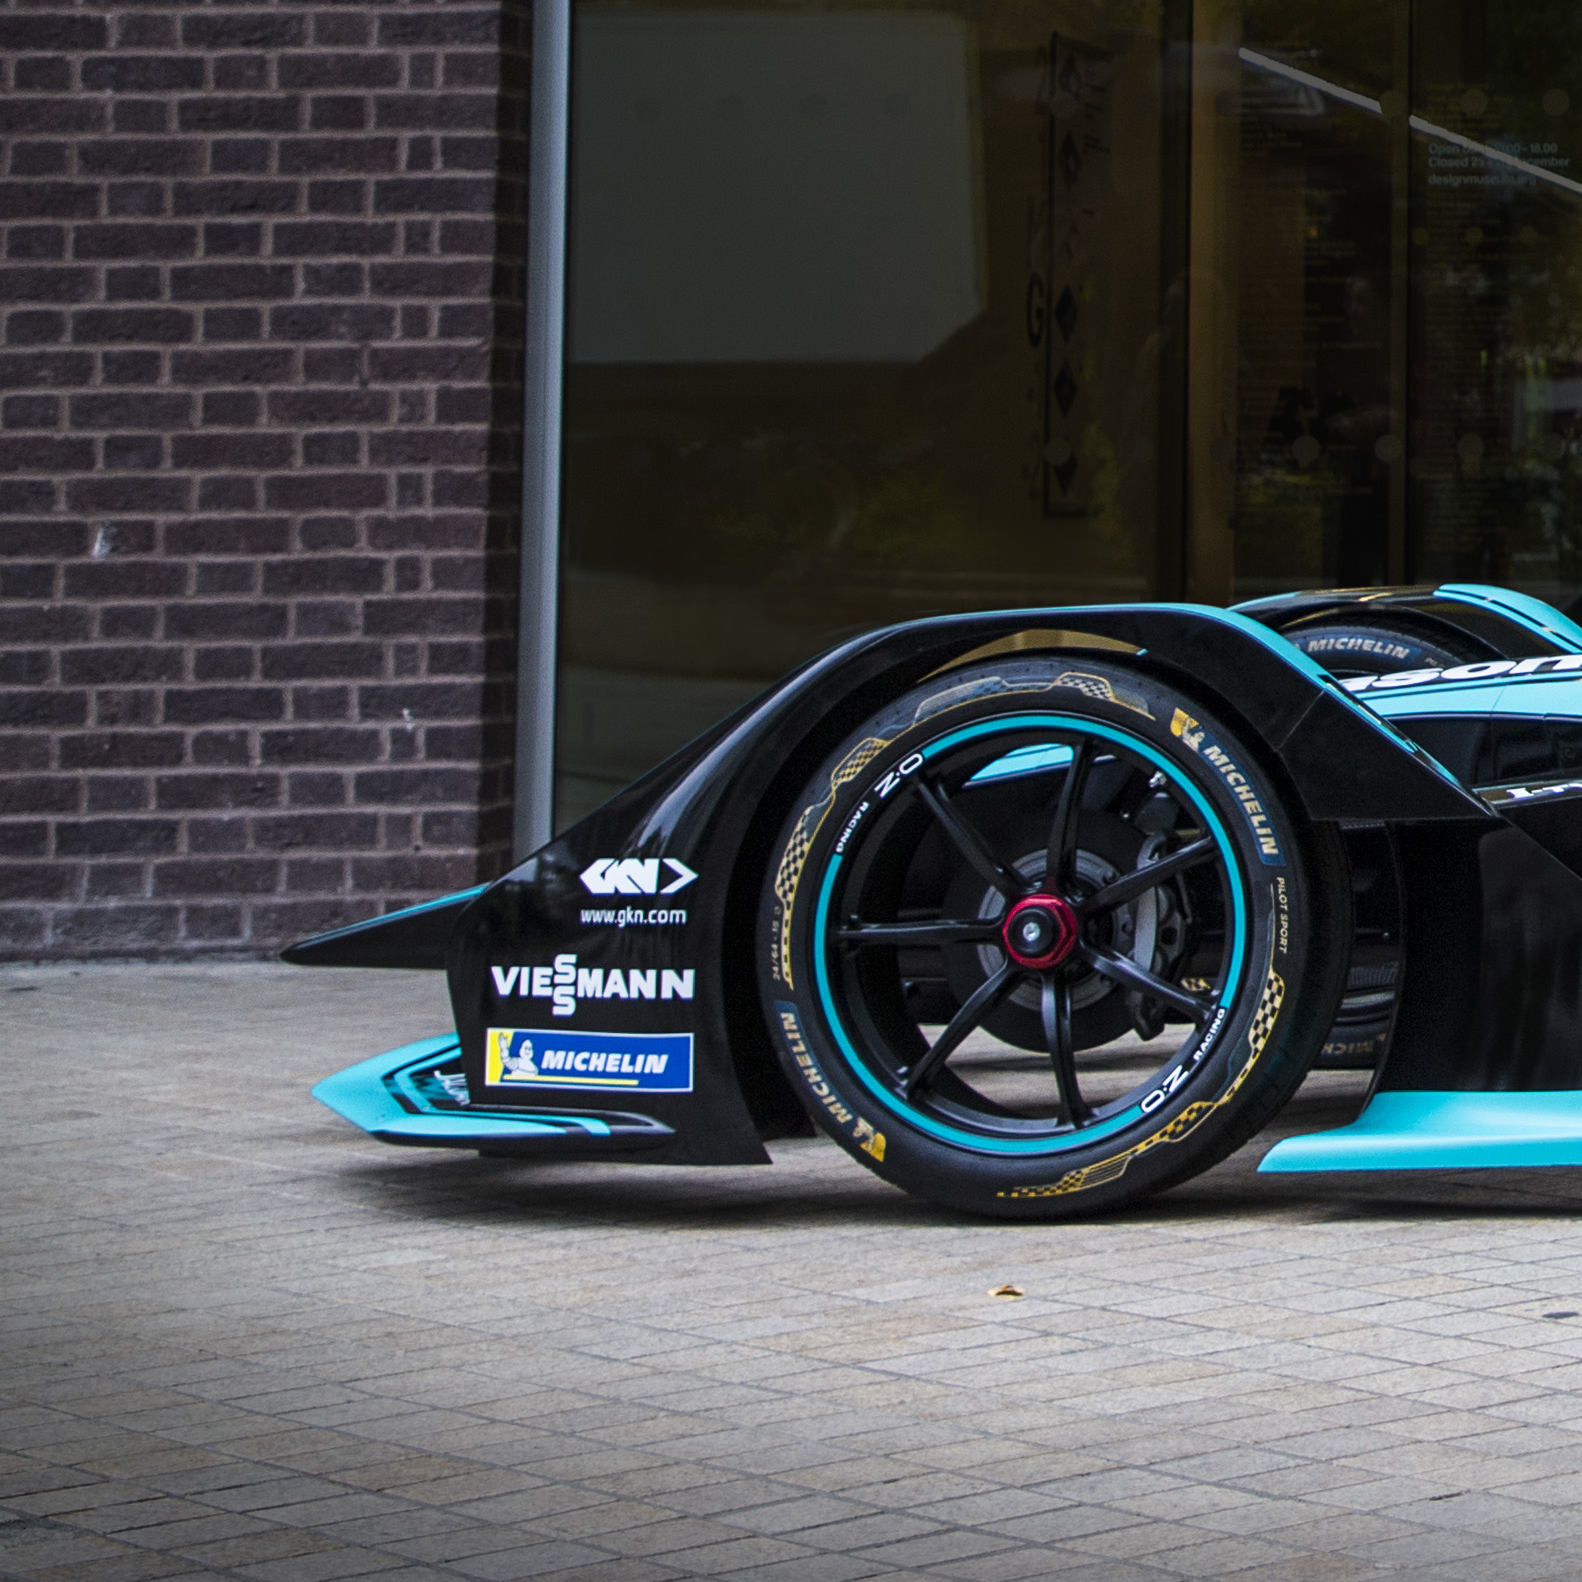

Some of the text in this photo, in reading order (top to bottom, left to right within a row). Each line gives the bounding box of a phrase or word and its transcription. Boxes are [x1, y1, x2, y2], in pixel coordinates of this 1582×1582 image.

[1307, 637, 1411, 659] MICHELIN
[1203, 744, 1280, 855] MICHELIN
[580, 905, 687, 929] www.gkn.com
[1276, 876, 1289, 955] PILOT SPORT
[490, 953, 695, 1017] VIESSMANN
[541, 1049, 669, 1075] MICHELIN
[1193, 1008, 1226, 1061] RACING
[780, 1011, 854, 1124] MICHELIN
